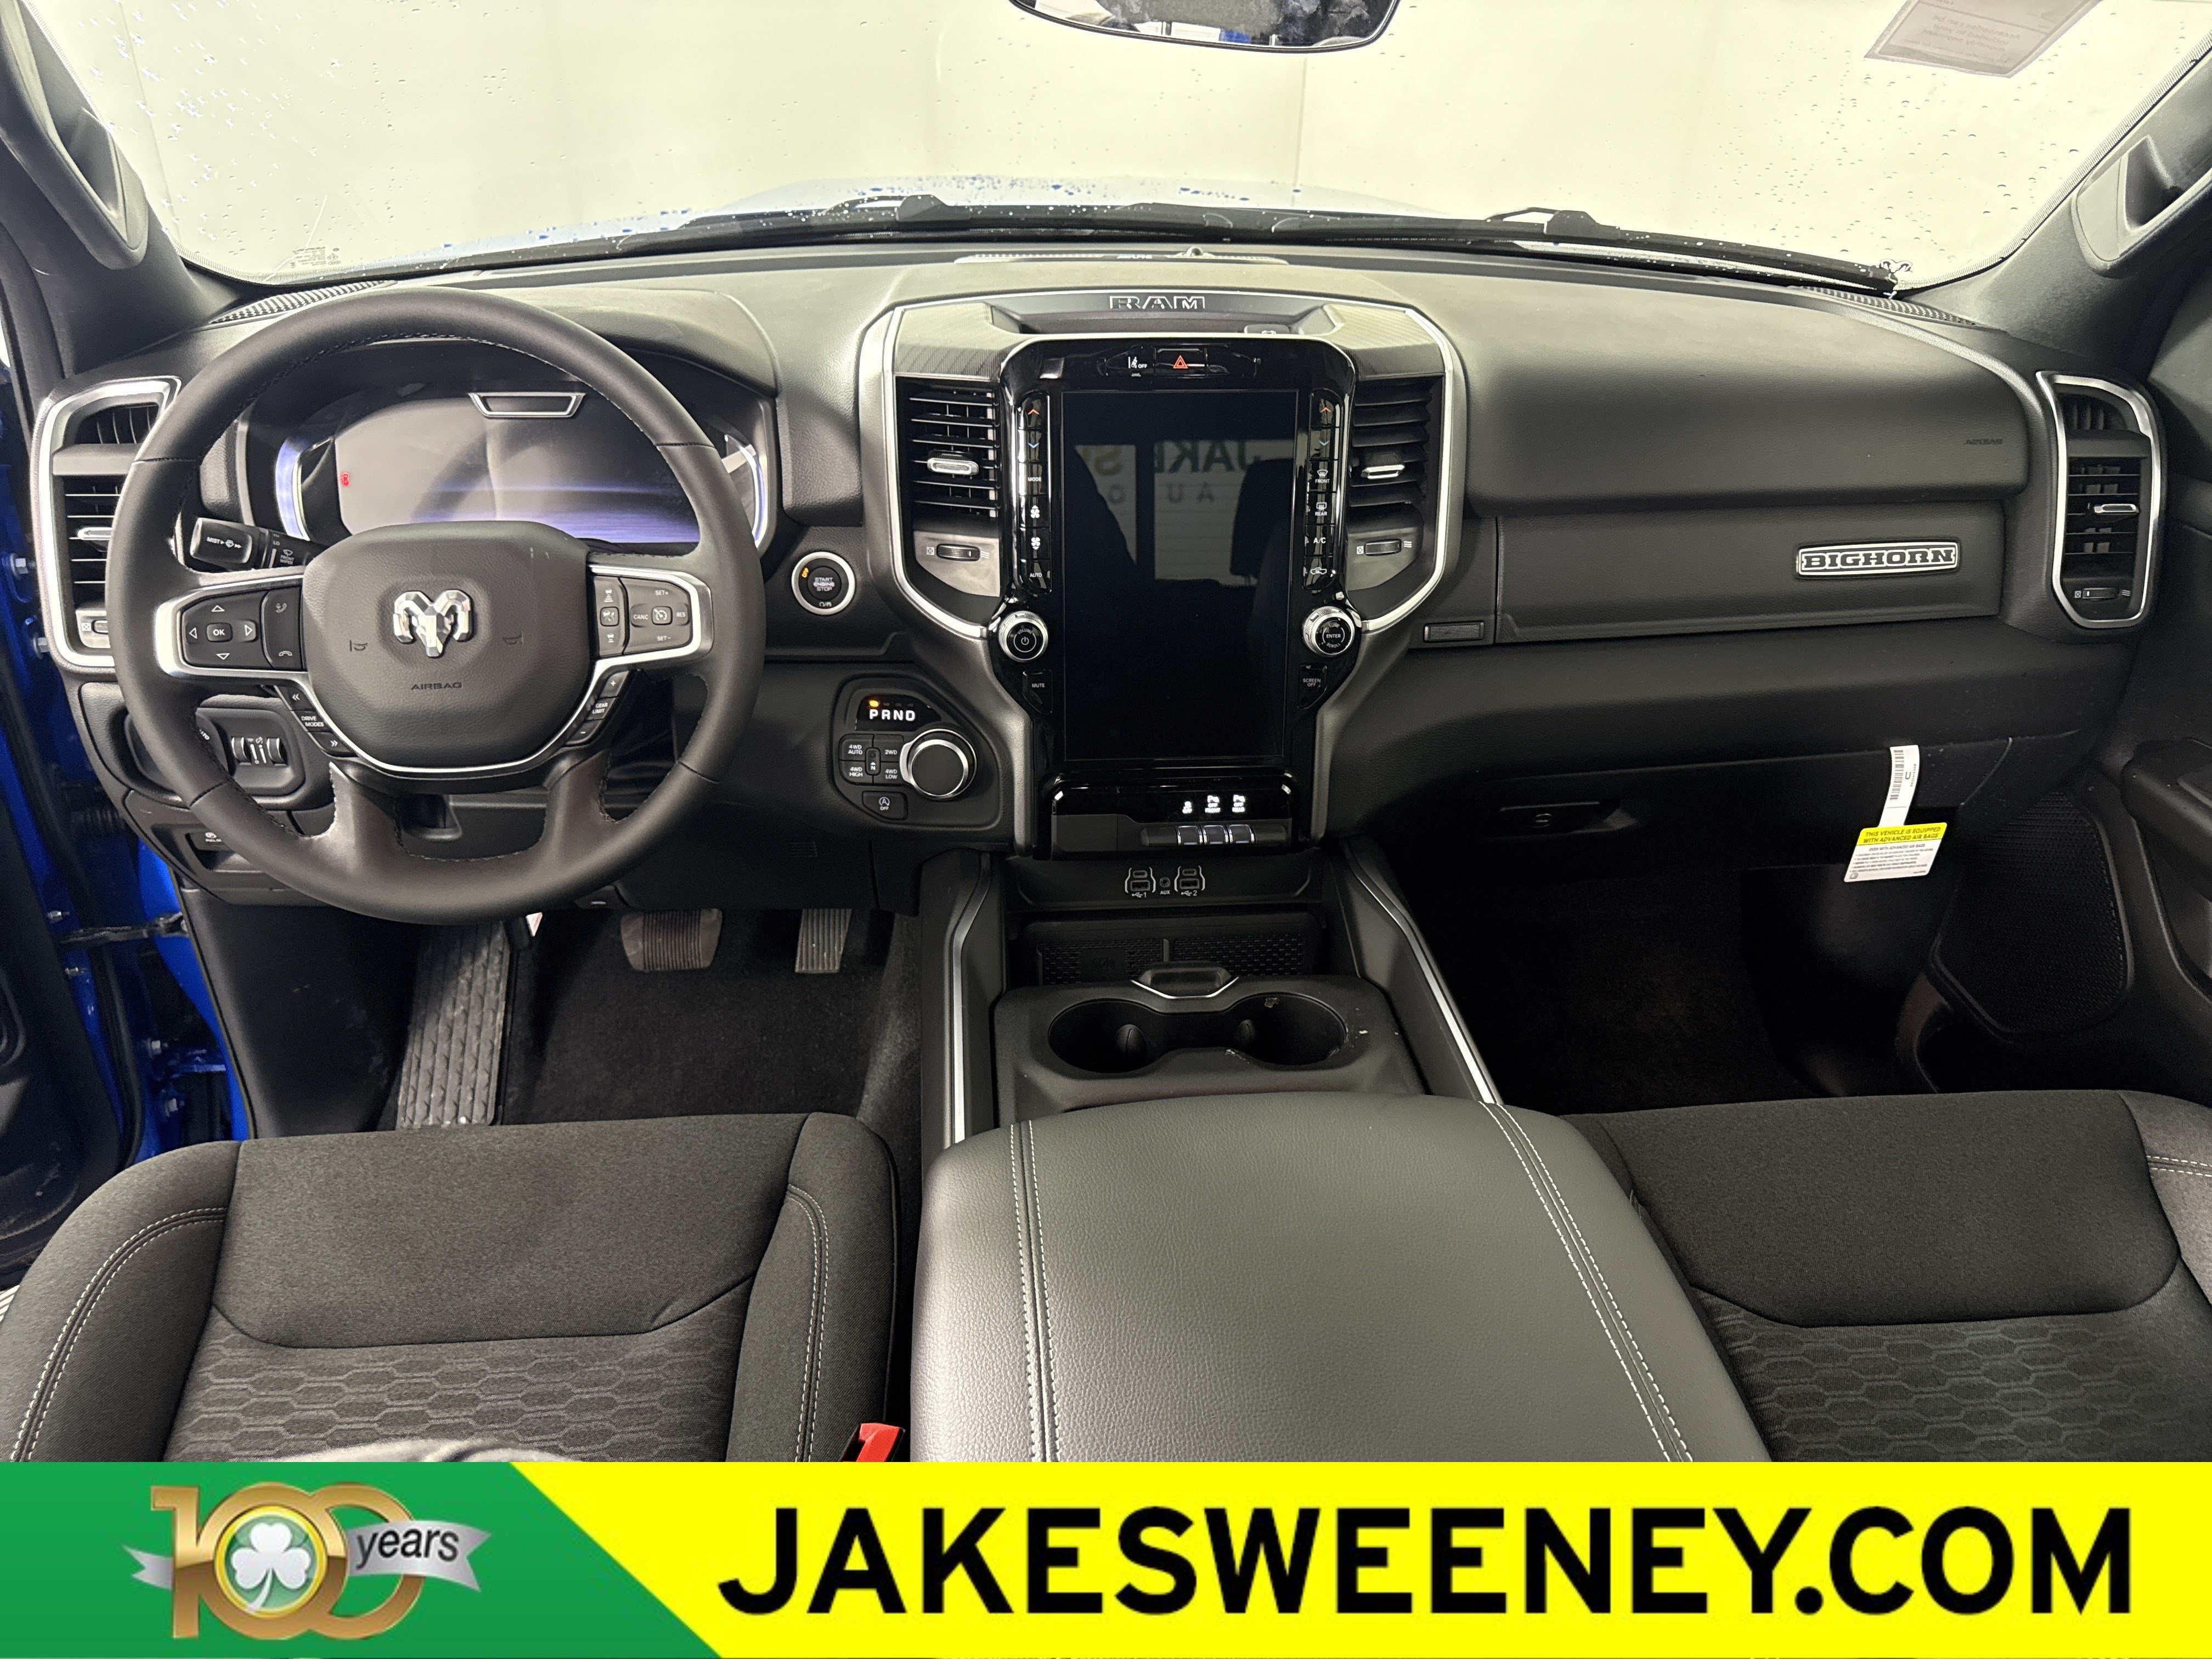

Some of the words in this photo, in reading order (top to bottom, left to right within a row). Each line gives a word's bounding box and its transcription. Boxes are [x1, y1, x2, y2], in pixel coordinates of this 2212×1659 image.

[1109, 295, 1205, 309] RAM
[207, 537, 221, 545] MIST
[1803, 548, 1954, 569] BIGHORN
[411, 682, 462, 691] AIRBAG
